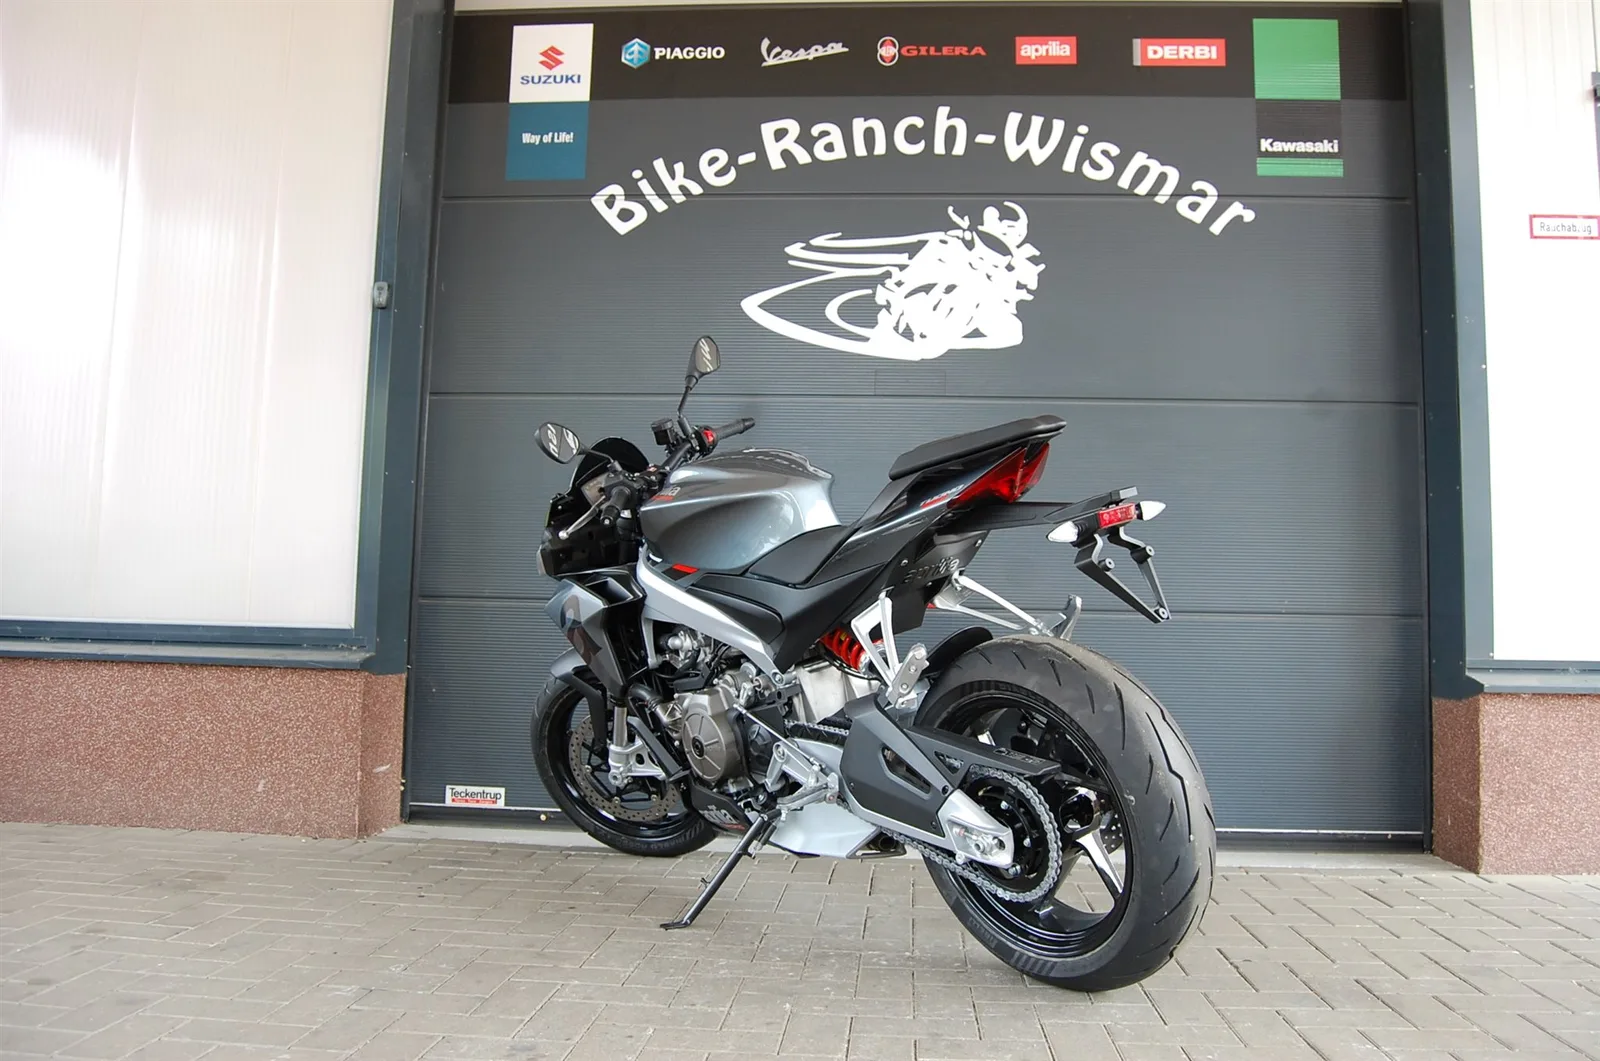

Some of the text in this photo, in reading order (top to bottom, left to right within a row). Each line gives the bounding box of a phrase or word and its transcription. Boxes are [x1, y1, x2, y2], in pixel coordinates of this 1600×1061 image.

[654, 46, 725, 61] PIAGGIO
[761, 37, 849, 67] Vespa
[900, 45, 987, 56] GILERA
[1020, 41, 1071, 60] aprilia
[1147, 44, 1217, 60] DERBI
[520, 74, 581, 86] SUZUKI
[522, 131, 574, 146] Way of Life!
[1260, 138, 1339, 154] Kawasaki
[448, 787, 502, 801] Teckentrup
